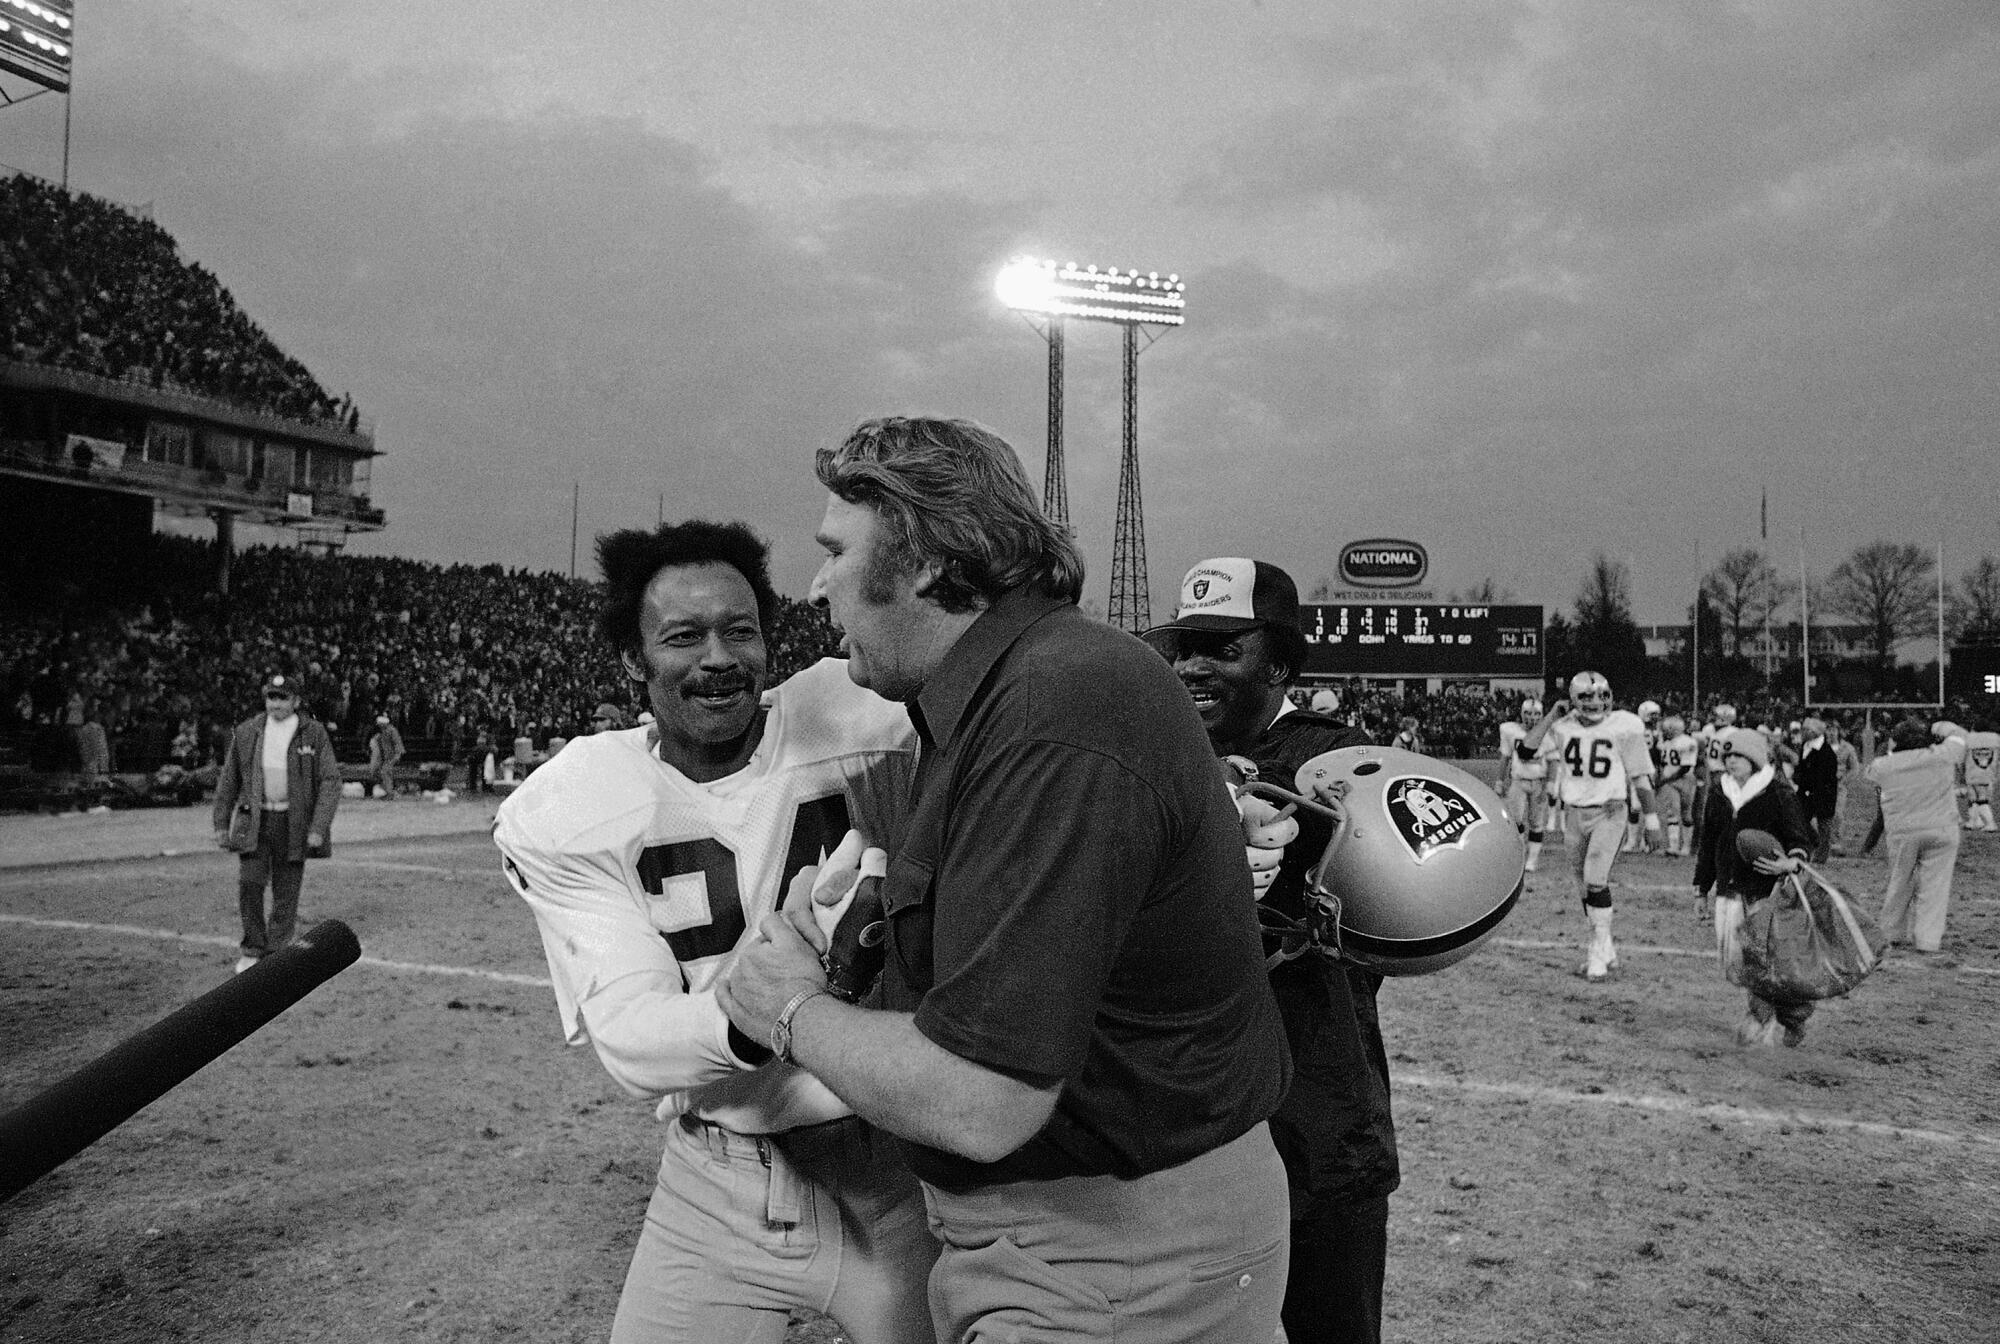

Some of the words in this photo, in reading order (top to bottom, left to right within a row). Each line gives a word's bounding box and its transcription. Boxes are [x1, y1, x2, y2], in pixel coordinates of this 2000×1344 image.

[1350, 552, 1416, 566] NATIONAL
[1198, 570, 1233, 583] CHAMPION
[1198, 594, 1232, 608] RAIDERS
[1463, 608, 1489, 618] LEFT
[1440, 634, 1453, 644] TO
[1458, 634, 1472, 644] GO
[1564, 738, 1613, 778] 46
[1419, 811, 1475, 850] RAIDERS
